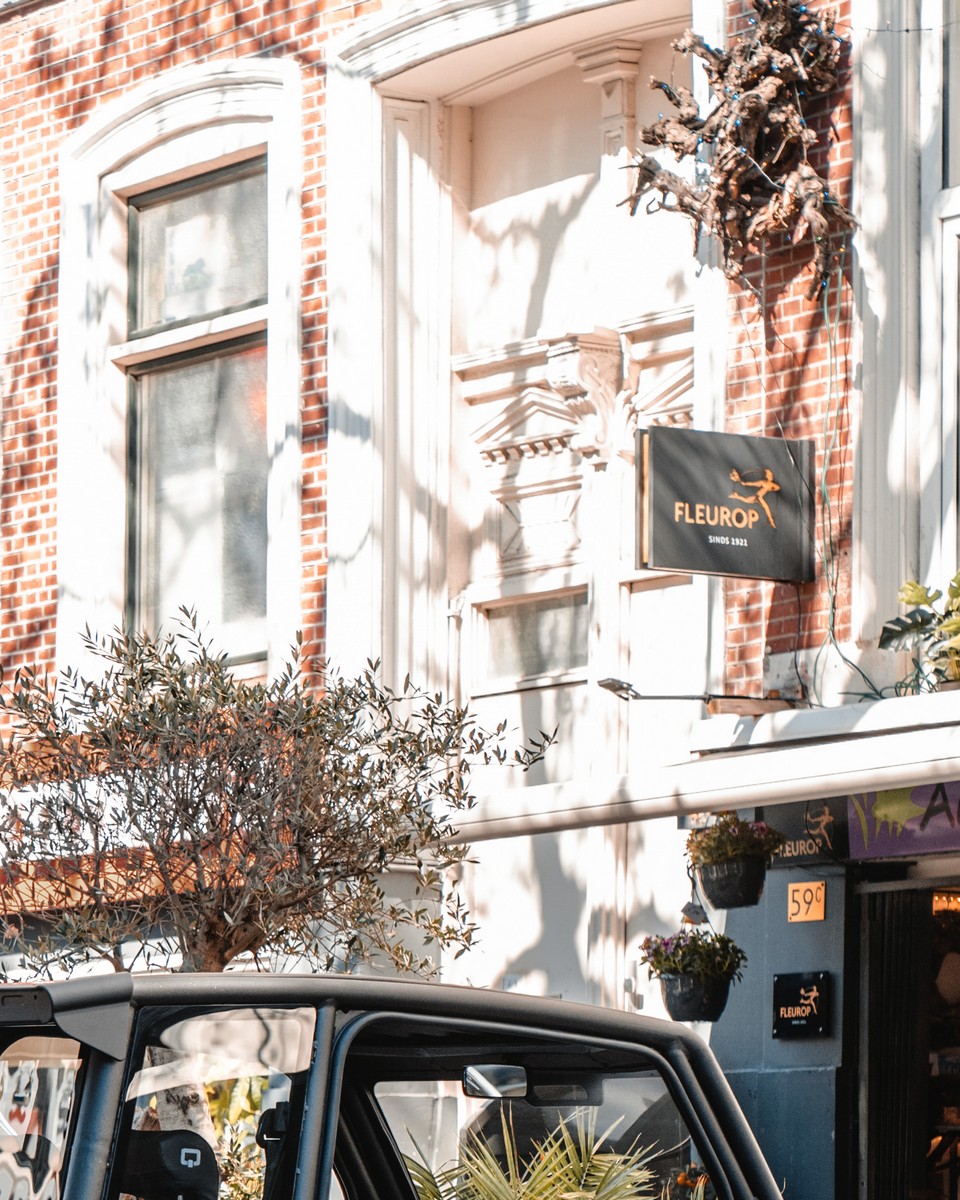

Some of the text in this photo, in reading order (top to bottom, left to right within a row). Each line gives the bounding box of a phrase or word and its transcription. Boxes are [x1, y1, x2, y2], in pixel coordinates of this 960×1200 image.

[674, 501, 760, 529] FLEUROP
[708, 535, 748, 547] SINDS 1921
[780, 1006, 811, 1019] FLEUROP
